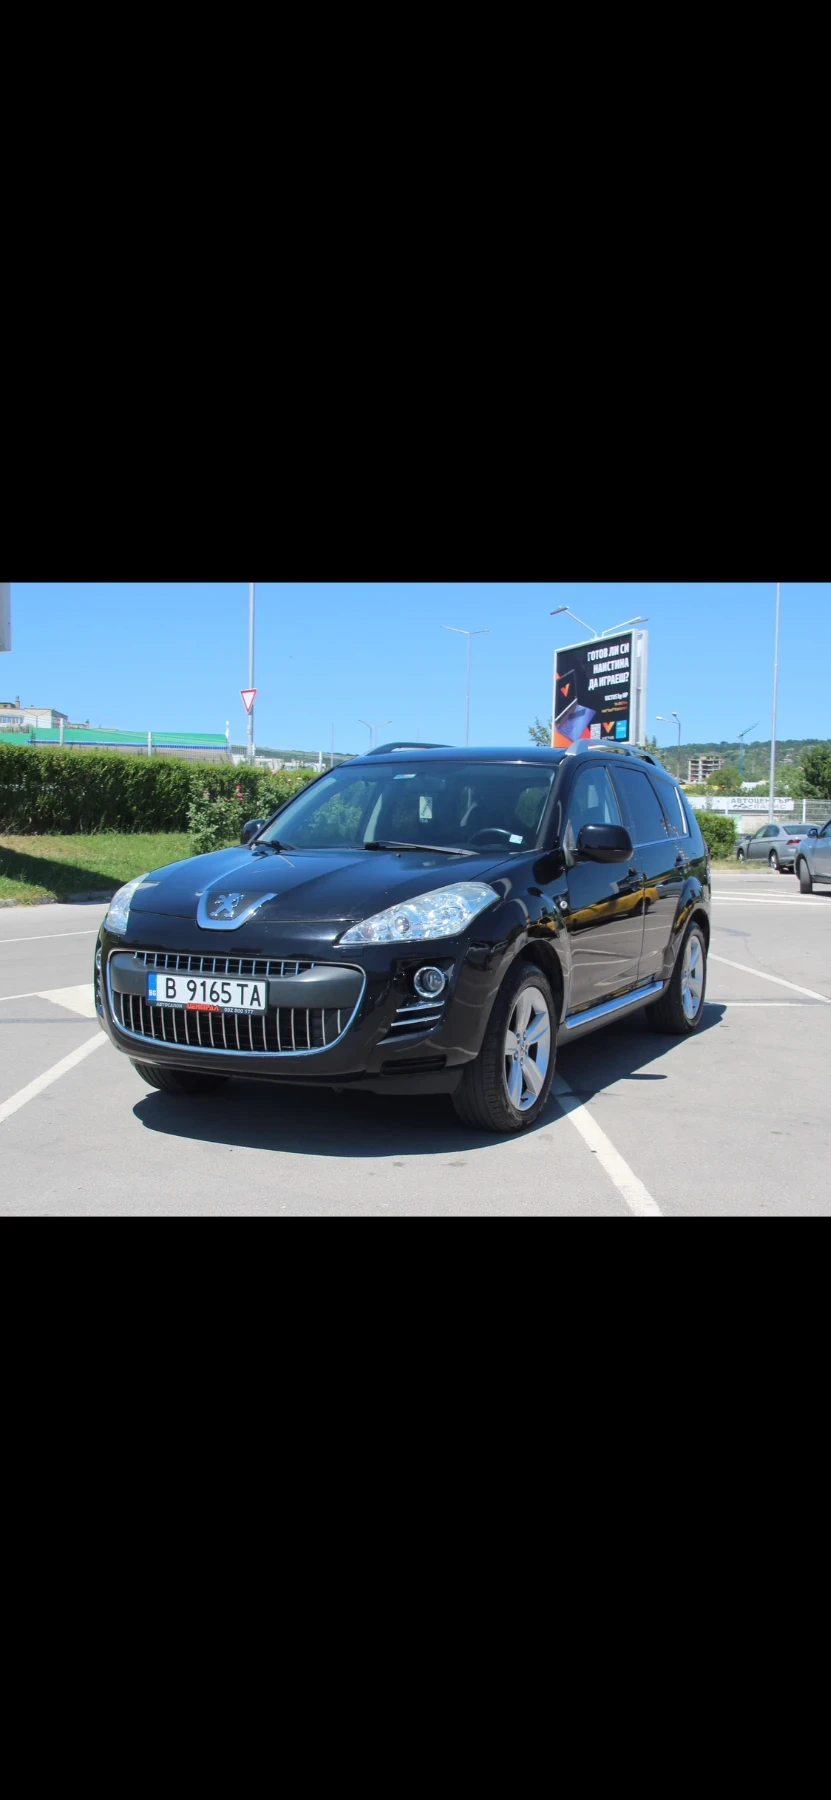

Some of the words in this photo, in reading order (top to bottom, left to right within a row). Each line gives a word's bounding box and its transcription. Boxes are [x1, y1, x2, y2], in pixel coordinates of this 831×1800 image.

[587, 648, 608, 661] ГОТОВ
[609, 645, 619, 657] ЛИ
[620, 643, 630, 654] СИ
[593, 657, 629, 674] НАИСТИНА
[588, 678, 598, 691] ДА
[599, 672, 629, 687] ИГРАЕШ?
[166, 978, 176, 999] B
